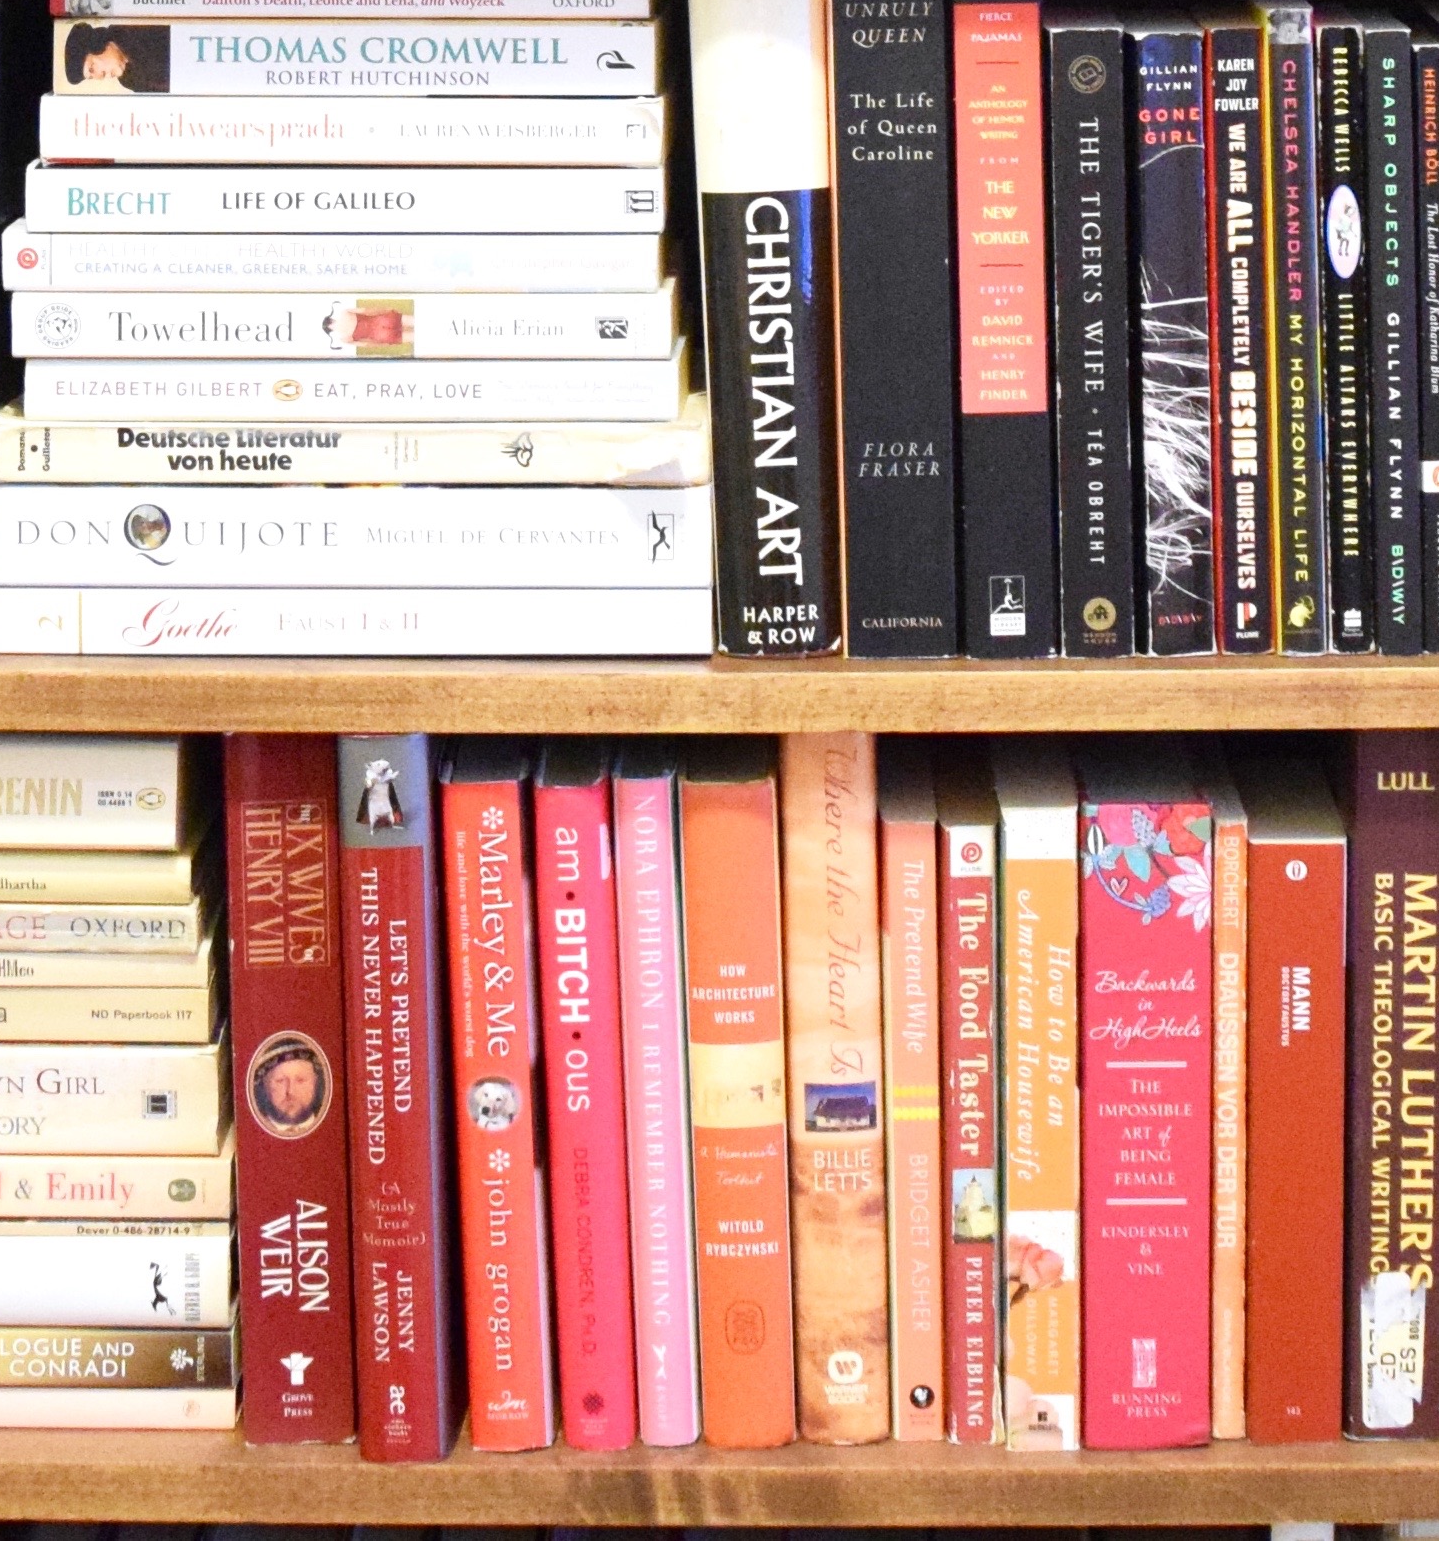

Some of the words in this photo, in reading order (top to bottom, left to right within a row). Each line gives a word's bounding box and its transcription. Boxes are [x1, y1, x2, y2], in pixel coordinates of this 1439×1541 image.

[845, 0, 933, 18] UNRULY
[852, 26, 927, 45] QUEEN
[190, 36, 347, 64] THOMAS
[360, 36, 570, 64] CROMWELL
[265, 69, 343, 86] ROBERT
[349, 69, 490, 86] HUTCHINSON
[1383, 58, 1395, 146] SHARP
[1079, 118, 1099, 176] THE
[1081, 192, 1101, 303] TIGER'S
[1385, 163, 1399, 287] OBJECTS
[745, 197, 797, 469] CHRISTIAN
[1085, 319, 1103, 395] WIFE
[1387, 313, 1401, 421] GILLIAN
[117, 428, 230, 448] Deutsche
[236, 429, 341, 448] Literatur
[167, 453, 212, 470] von
[220, 451, 292, 470] heute
[1390, 438, 1403, 520] FLYNN
[756, 485, 803, 585] ART
[1089, 481, 1105, 565] OBREHT
[743, 605, 819, 624] HARPER
[748, 630, 762, 644] &
[769, 625, 816, 644] ROW
[862, 617, 944, 629] CALIFORNIA
[1377, 771, 1435, 791] LULL
[361, 868, 379, 928] THIS
[474, 830, 507, 966] Marley
[957, 893, 987, 951] The
[363, 935, 381, 1019] NEVER
[389, 919, 408, 983] LET'S
[483, 966, 515, 991] &
[1402, 873, 1437, 1053] MARTIN
[483, 1001, 516, 1058] Me
[959, 964, 989, 1042] Food
[35, 1067, 104, 1095] GIRL
[391, 991, 411, 1113] PRETEND
[366, 1030, 385, 1165] HAPPENED
[959, 1056, 988, 1156] Taster
[1401, 1068, 1434, 1291] LUTHER'S
